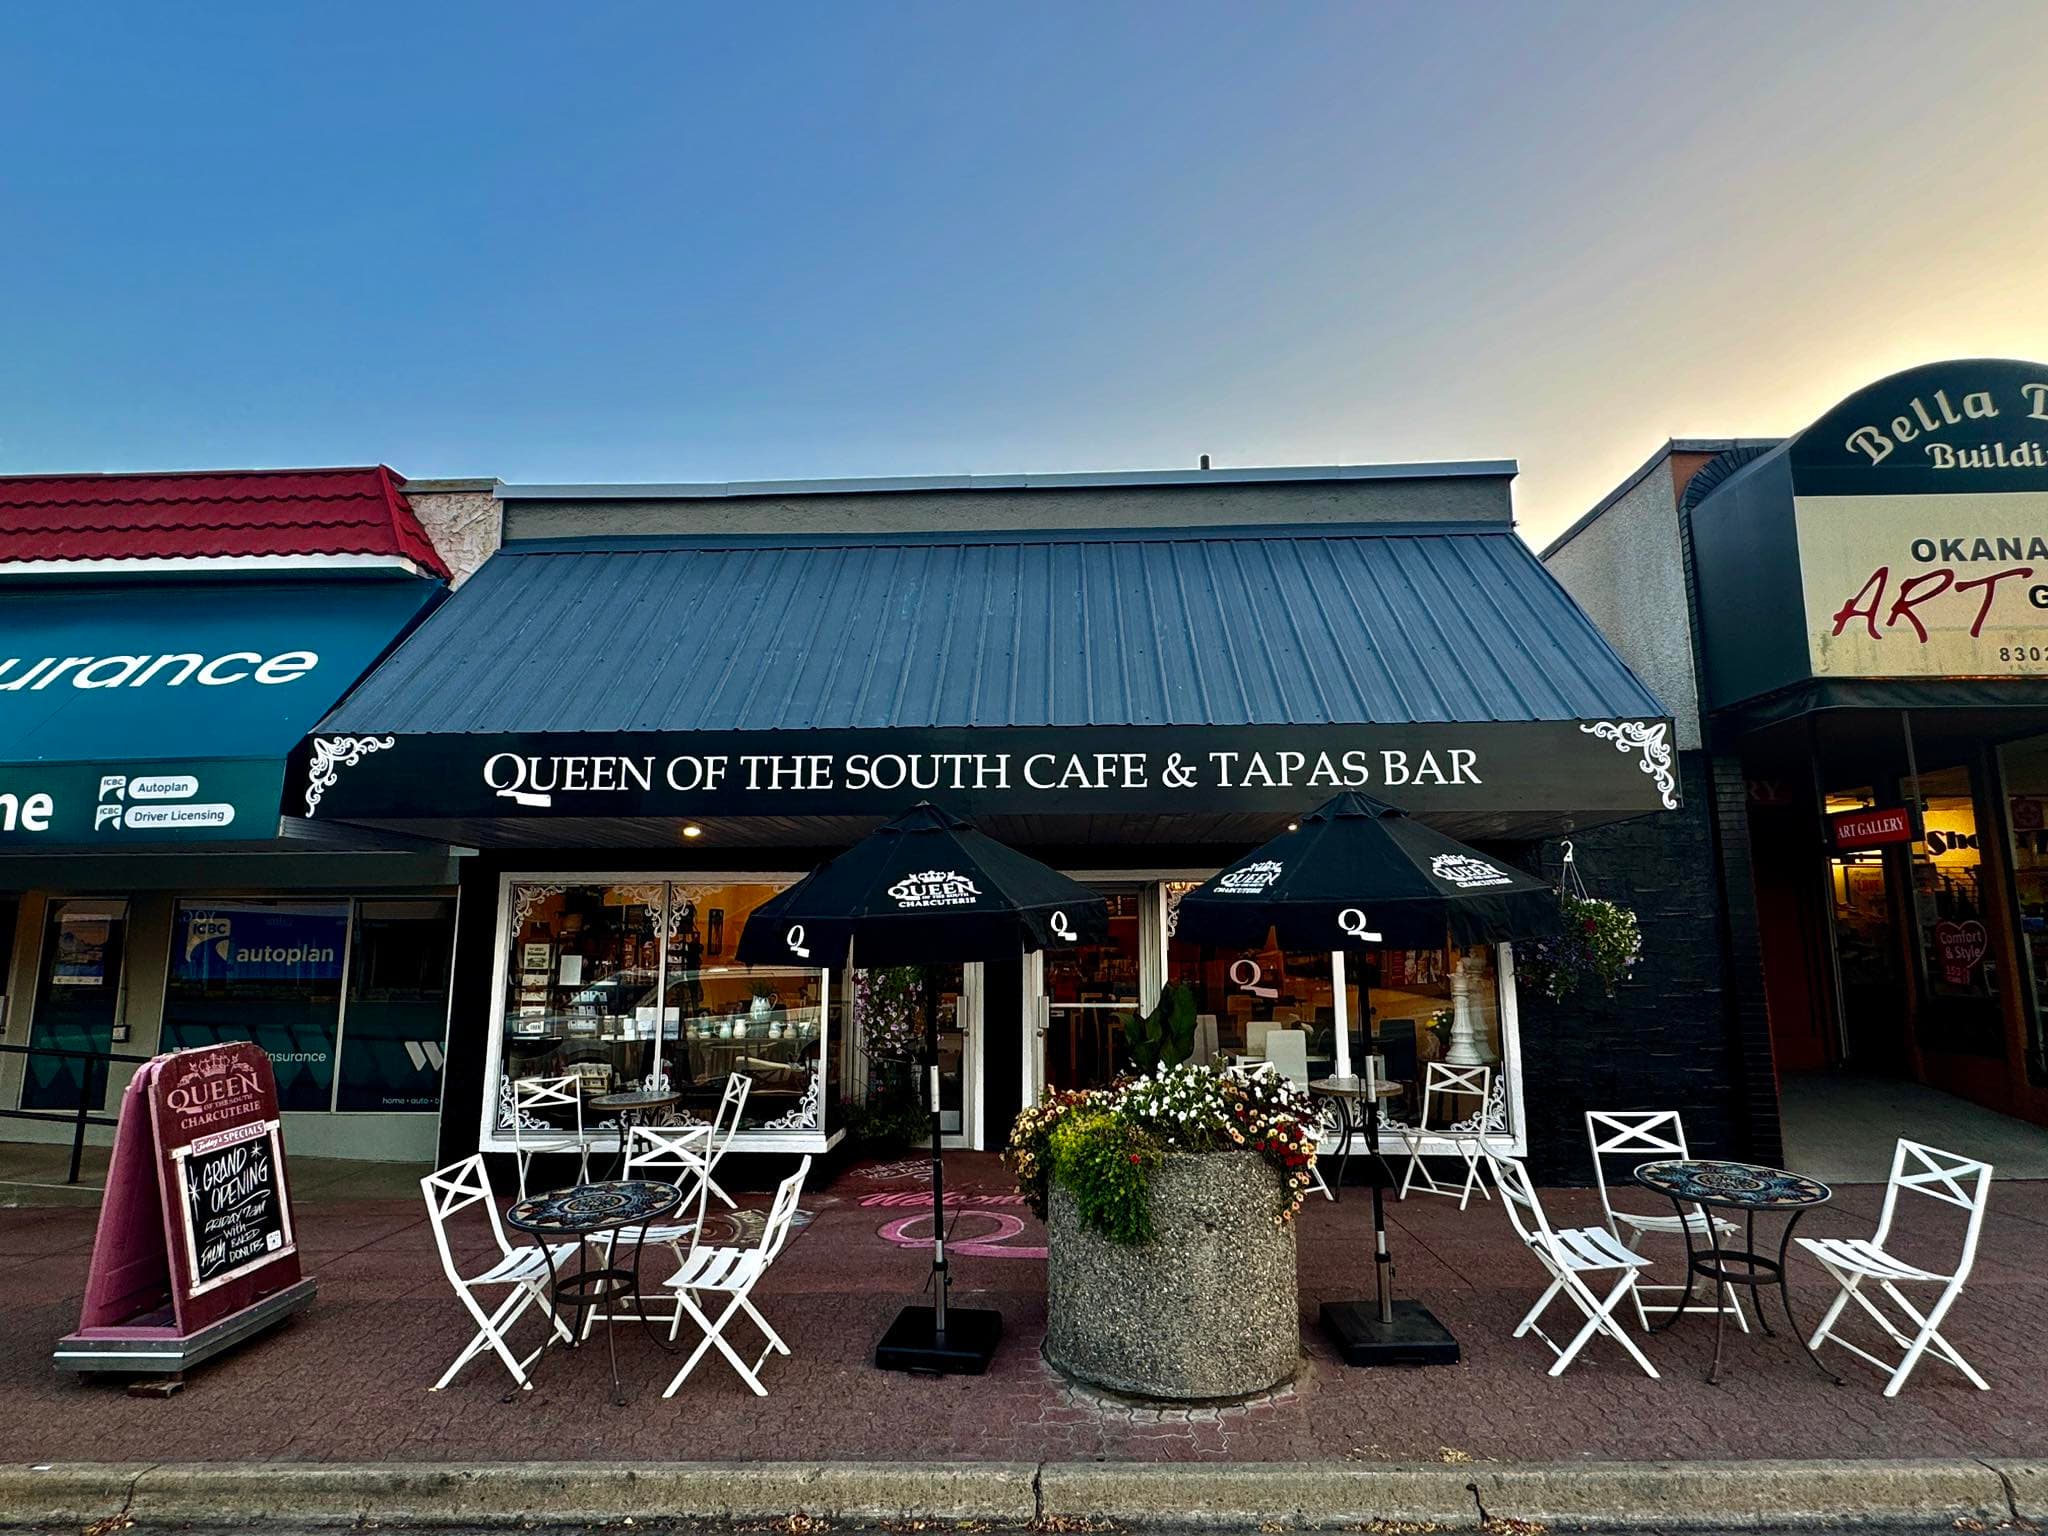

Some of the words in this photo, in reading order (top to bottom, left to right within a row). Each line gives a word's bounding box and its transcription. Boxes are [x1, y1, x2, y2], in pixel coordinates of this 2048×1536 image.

[1846, 389, 2000, 467] Bella
[1925, 441, 2048, 470] Buildi
[1911, 537, 2048, 562] OKANA
[1832, 566, 2033, 643] ART
[138, 782, 188, 794] Autoplan
[483, 753, 655, 807] QUEEN
[667, 756, 728, 791] OF
[740, 755, 834, 790] THE
[846, 753, 1011, 790] SOUTH
[1023, 752, 1148, 789] CAFE
[1162, 751, 1199, 789] &
[1209, 749, 1369, 788] TAPAS
[1380, 748, 1483, 786] BAR
[134, 812, 168, 822] Driver
[171, 810, 225, 822] Licensing
[1838, 825, 1856, 839] ART
[1857, 817, 1905, 836] GALLERY
[1220, 871, 1280, 887] QUEEN
[1432, 863, 1508, 882] QUEEN
[888, 881, 982, 900] QUEEN
[193, 923, 226, 934] ICBC
[1051, 911, 1077, 941] Q
[1338, 908, 1382, 942] Q
[236, 944, 334, 966] autoplan
[787, 925, 809, 958] Q
[1955, 944, 1982, 961] Style
[1230, 959, 1279, 998] Q
[167, 1072, 265, 1113] QUEEN
[181, 1100, 261, 1129] CHARCUTERIE
[222, 1124, 263, 1143] SPECIALS
[203, 1147, 247, 1192] GRAND
[211, 1156, 267, 1213] OPENING
[205, 1208, 242, 1234] FRIDAY
